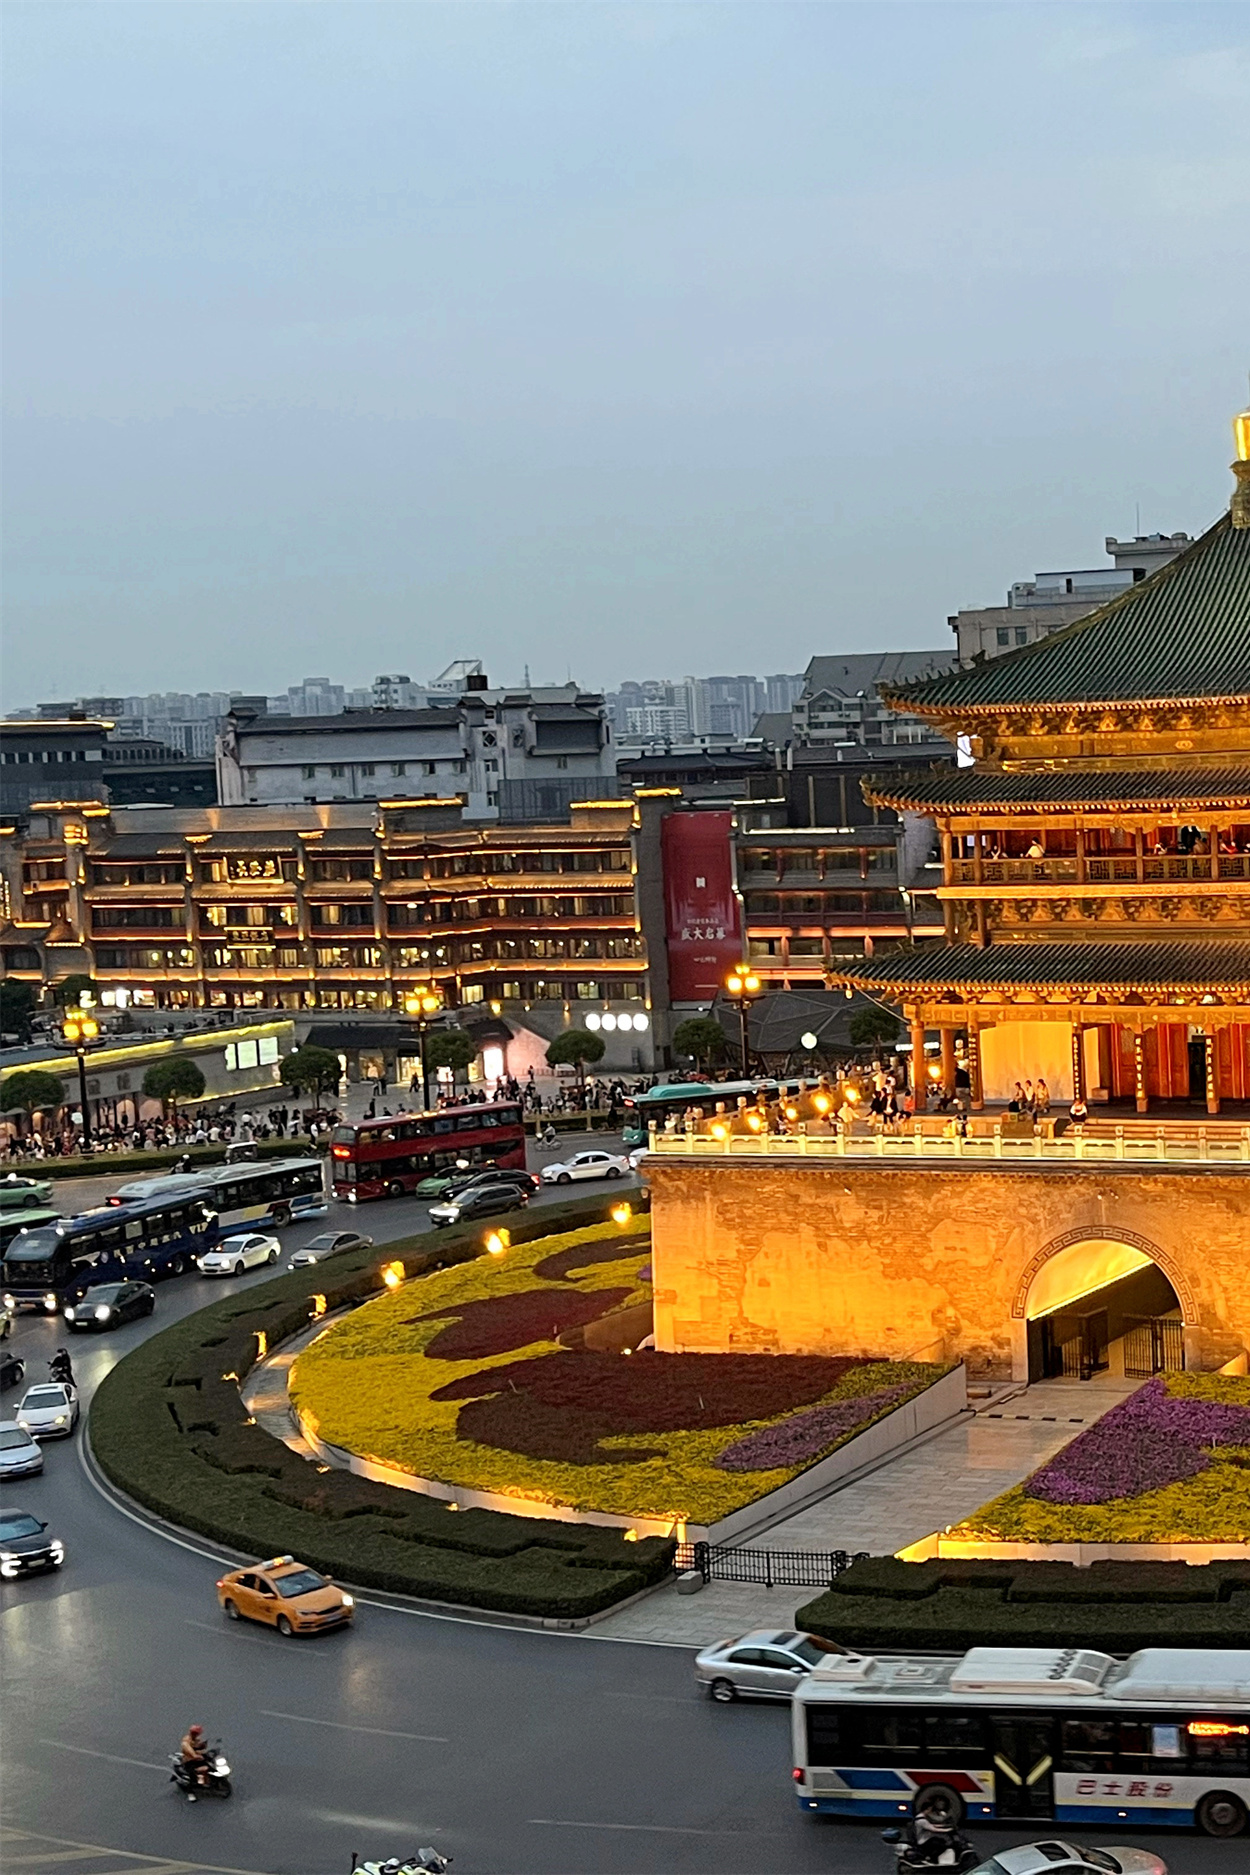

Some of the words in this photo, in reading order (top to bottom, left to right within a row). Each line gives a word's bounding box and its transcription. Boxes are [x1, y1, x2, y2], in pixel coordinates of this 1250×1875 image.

[189, 1221, 209, 1235] VIP
[1076, 1779, 1174, 1798] 巴士股份
